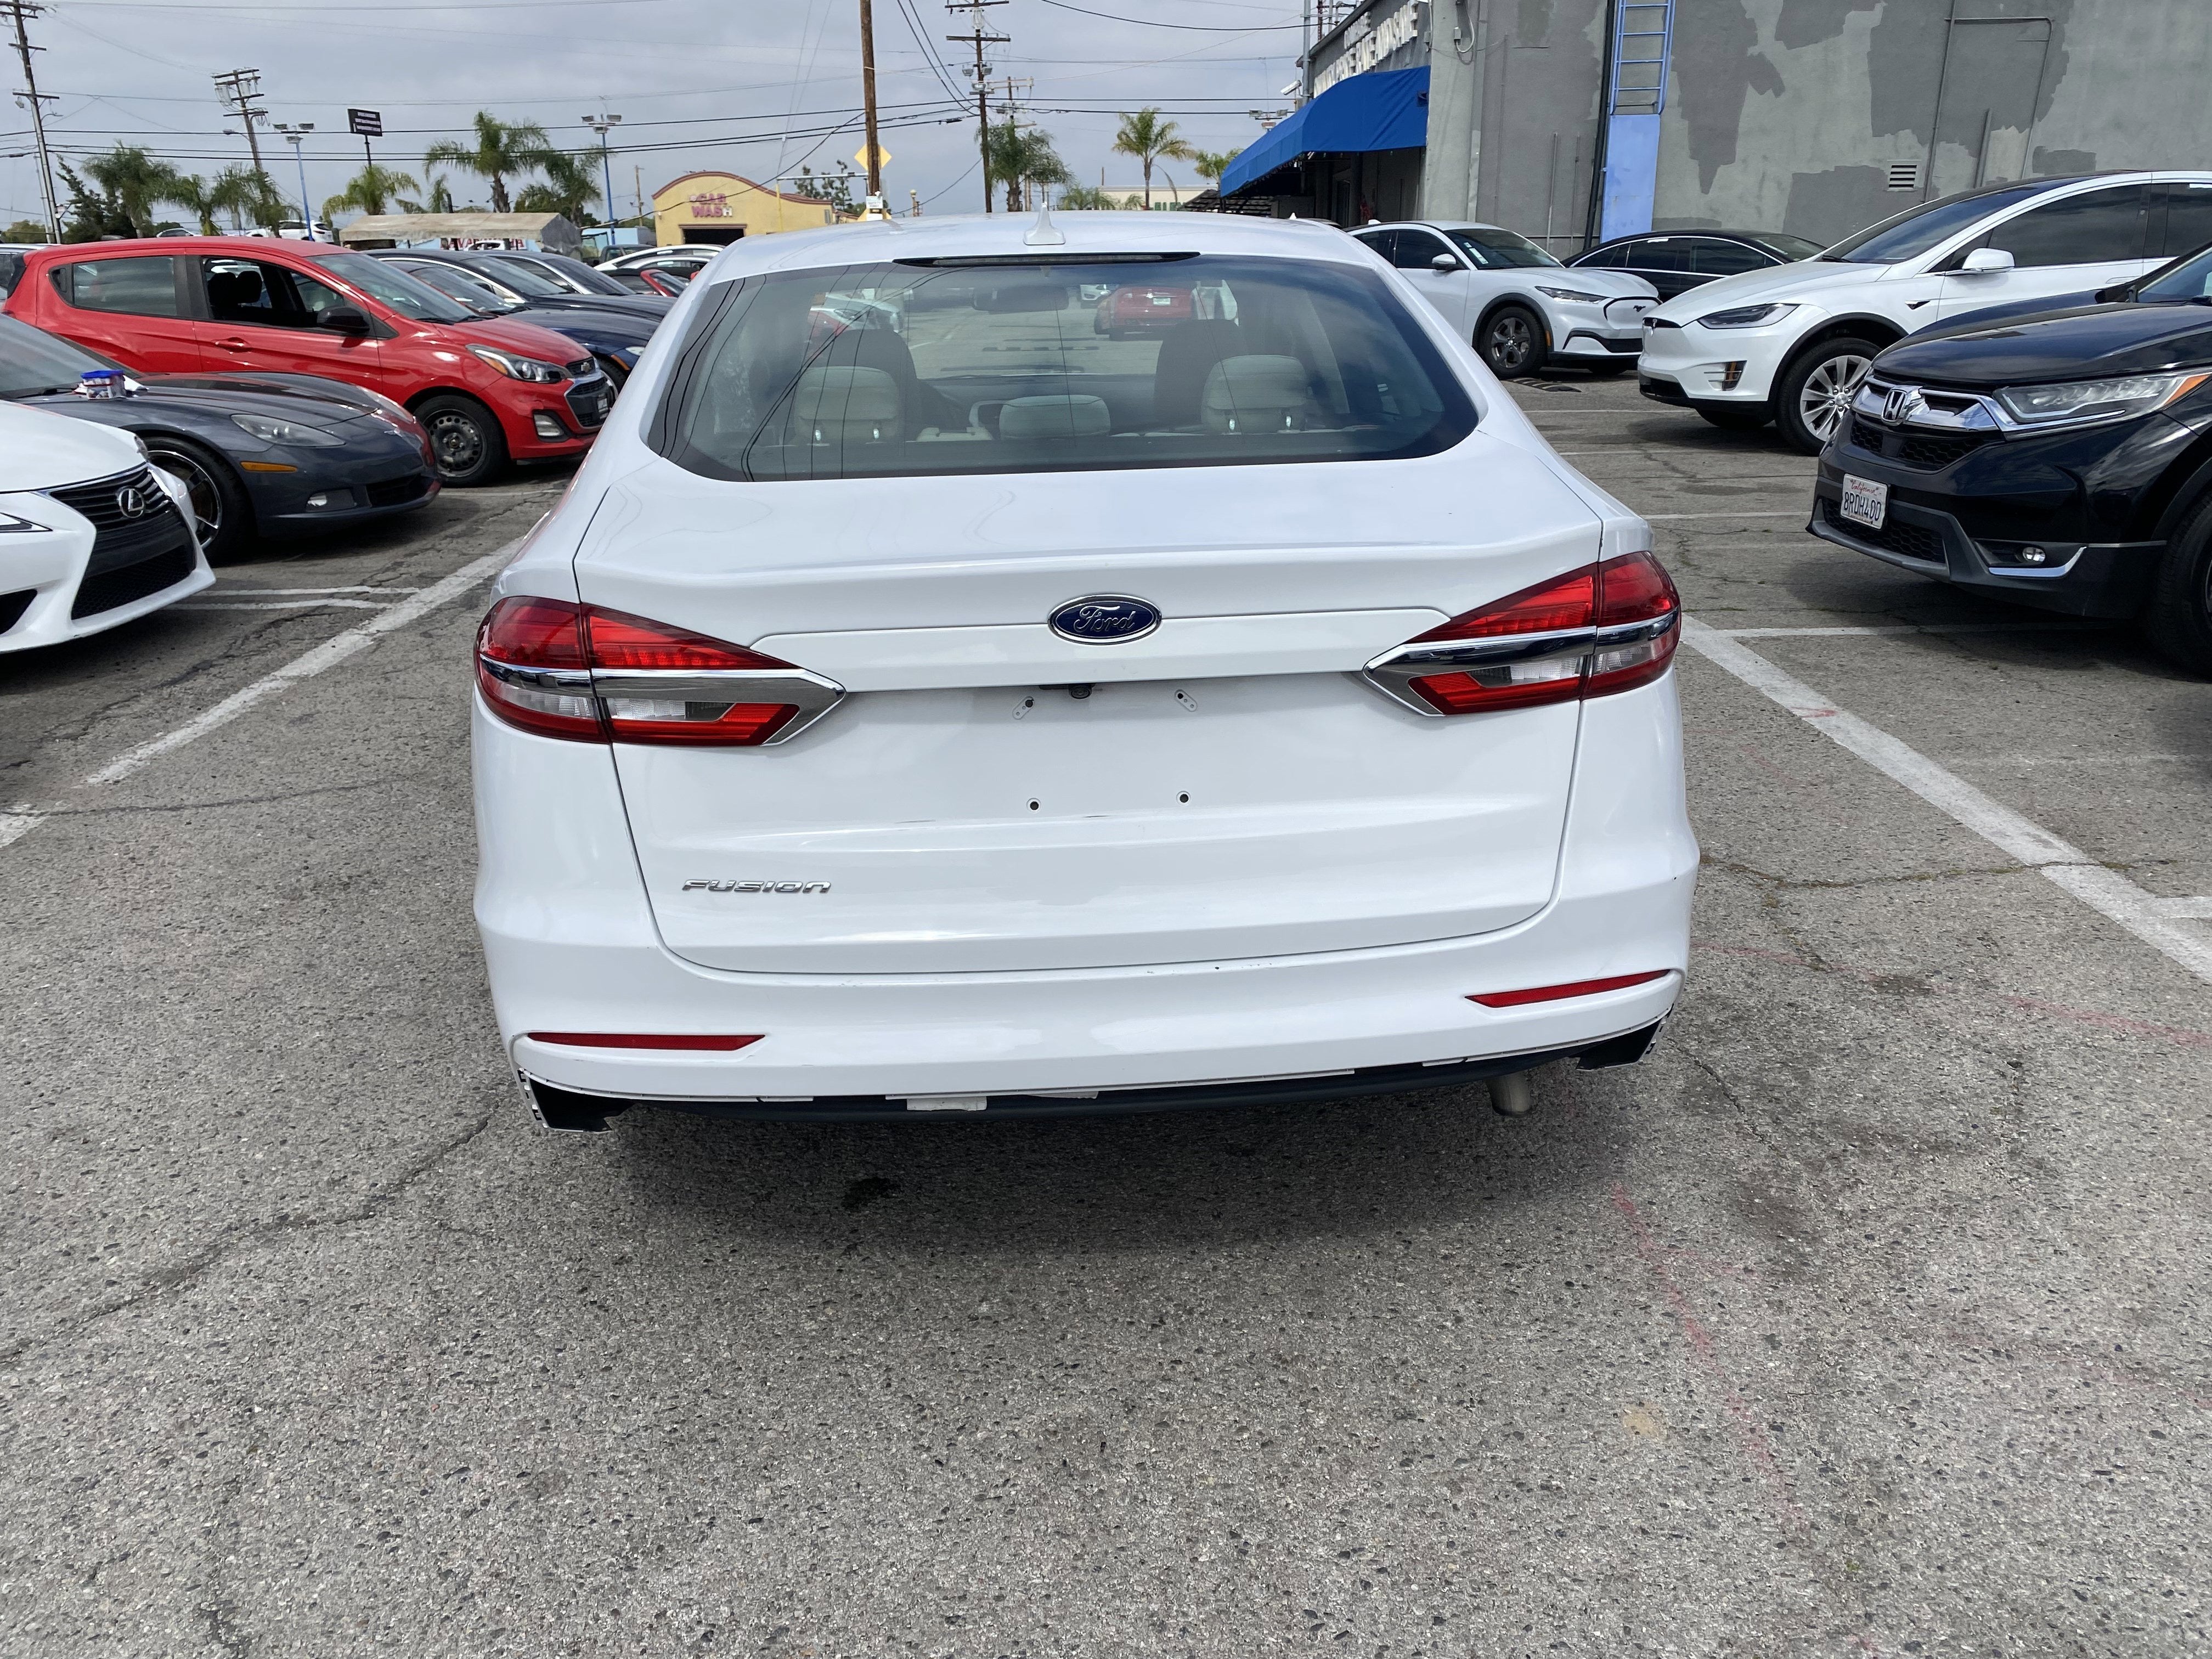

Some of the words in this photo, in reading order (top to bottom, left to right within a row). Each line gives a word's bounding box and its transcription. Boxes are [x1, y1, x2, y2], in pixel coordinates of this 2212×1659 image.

[691, 206, 732, 218] WASH
[1074, 606, 1136, 633] Ford
[682, 879, 832, 894] FUSION
